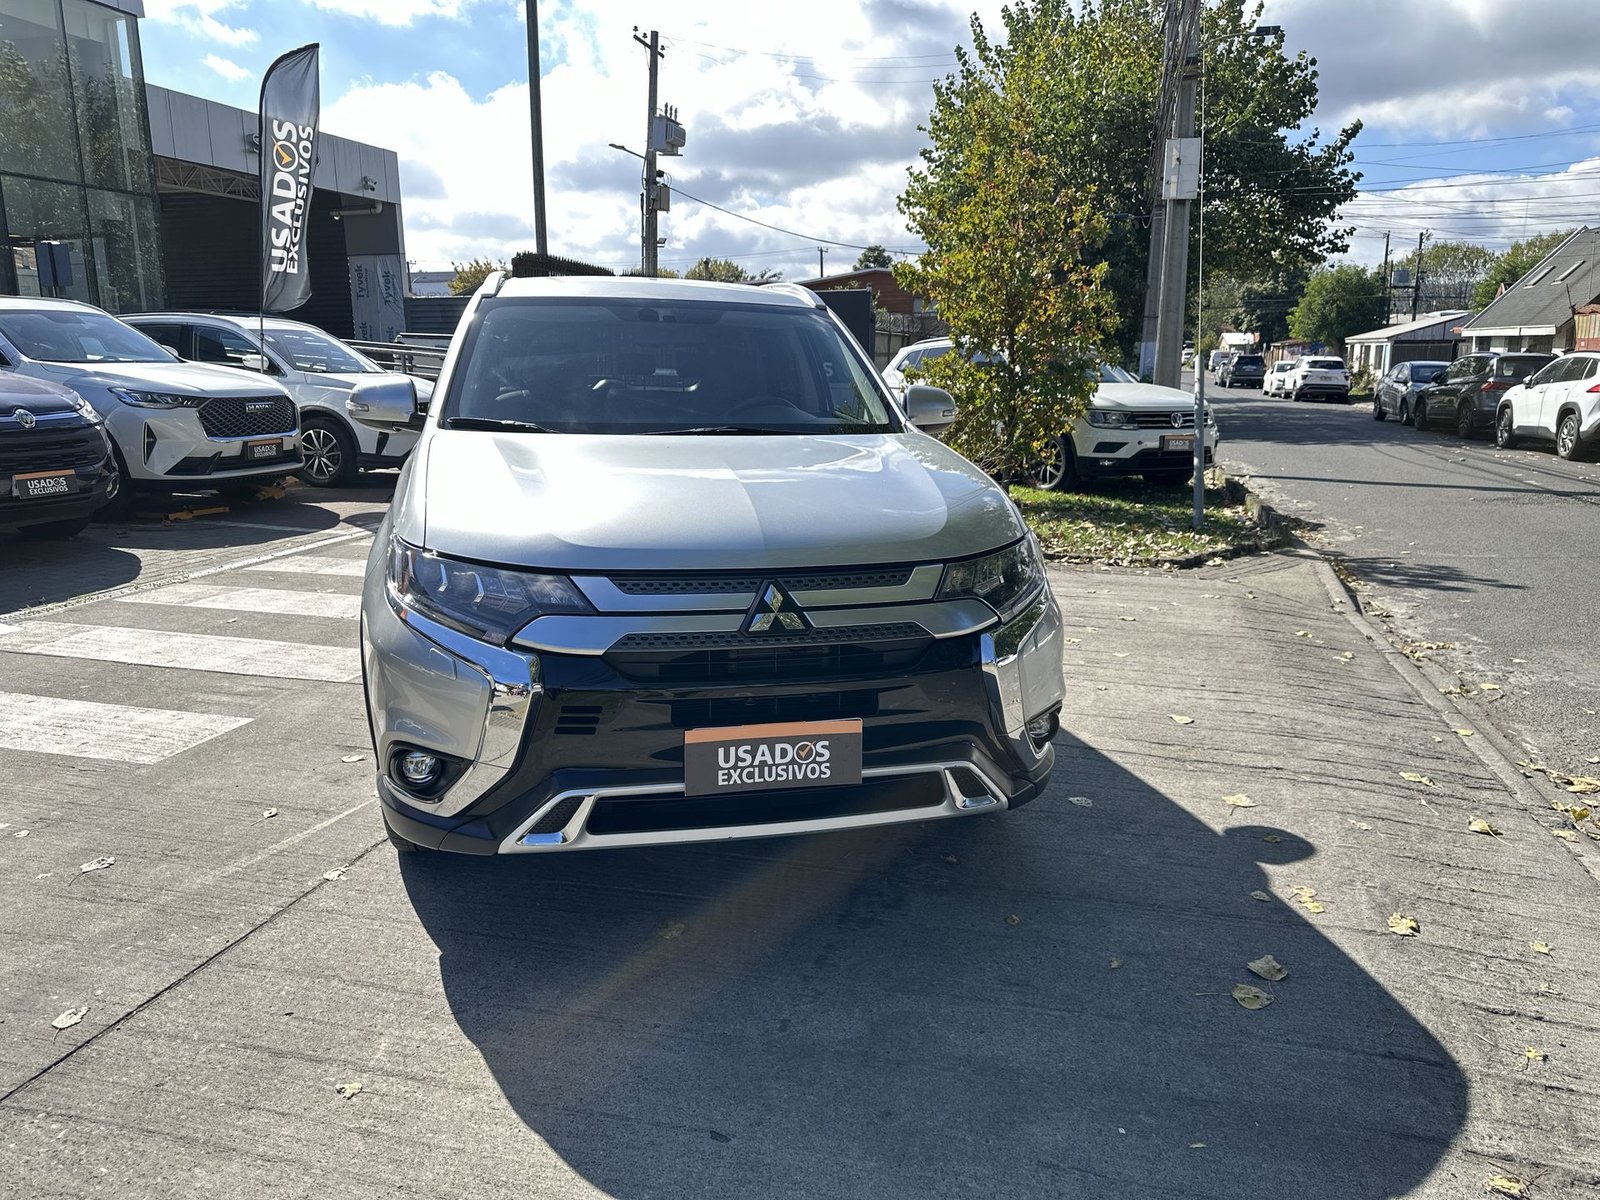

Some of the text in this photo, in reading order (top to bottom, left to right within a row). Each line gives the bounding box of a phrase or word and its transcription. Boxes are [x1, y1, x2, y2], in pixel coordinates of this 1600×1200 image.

[271, 119, 298, 273] USADOS
[286, 124, 314, 275] EXCLUSIVOS
[355, 264, 366, 300] Tyvek
[382, 270, 392, 305] Tyvek
[359, 321, 368, 340] vek
[27, 477, 66, 489] USADOS
[29, 485, 68, 495] EXCLUSIVOS
[717, 740, 831, 769] USADOS
[717, 762, 831, 786] EXCLUSIVOS
